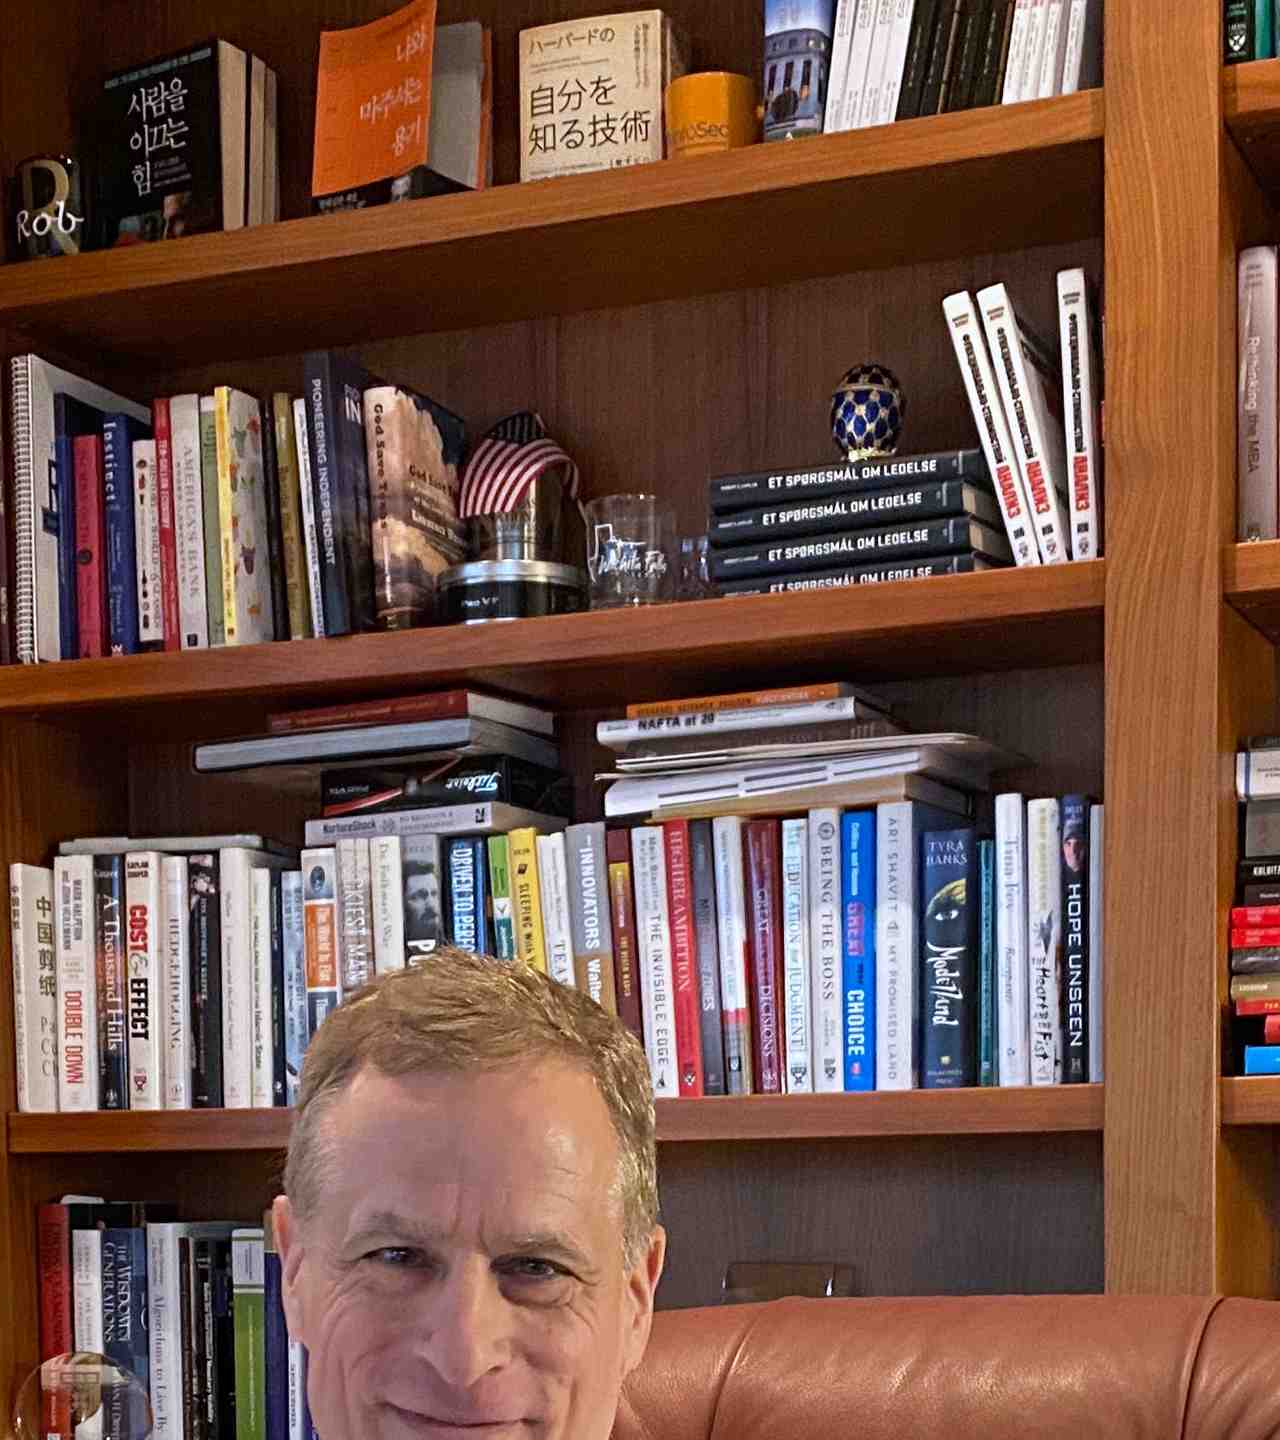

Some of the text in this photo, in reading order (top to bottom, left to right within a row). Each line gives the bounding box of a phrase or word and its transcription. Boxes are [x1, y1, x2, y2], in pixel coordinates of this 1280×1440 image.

[529, 27, 616, 55] ハーバードの
[128, 77, 188, 122] 사람을
[530, 75, 617, 118] 自分を
[129, 118, 190, 159] 이끄는
[528, 110, 652, 157] 知る技術
[132, 161, 151, 197] 힘
[17, 200, 85, 244] Rob
[373, 404, 386, 435] God
[103, 421, 119, 502] Instinct
[311, 378, 336, 566] PIONEERING INDEPENDENT
[375, 441, 388, 478] Save
[768, 475, 784, 489] ET
[785, 465, 860, 487] SPØRGSMÅL
[861, 465, 880, 479] OM
[883, 458, 937, 476] LEDELSE
[1073, 454, 1091, 512] АНАЛИЗ
[1248, 440, 1259, 474] MBA
[762, 511, 777, 525] ET
[778, 500, 848, 523] SPØRGSMÅL
[850, 498, 869, 513] OM
[871, 491, 922, 510] LEDELSE
[995, 464, 1021, 519] АНАЛИЗ
[1025, 460, 1050, 515] АНАЛИЗ
[188, 549, 201, 598] BANK
[638, 712, 715, 731] NAFTA at 20
[926, 854, 968, 866] BANKS
[929, 840, 964, 853] TYRA
[1003, 837, 1019, 910] Tina Fey
[380, 864, 391, 922] Folkman's
[451, 848, 474, 912] DRIVEN TO
[518, 883, 533, 929] SLEEPING
[579, 847, 600, 950] INNOVATORS
[669, 830, 691, 993] HIGHER AMBITION
[820, 845, 834, 1001] BEING THE BOSS
[103, 893, 123, 1051] A Thousand Hills
[130, 904, 150, 1040] COST EFFECT
[887, 817, 898, 1081] ARI SHAVIT MY PROMISED LAND
[1067, 882, 1082, 1046] HOPE UNSEEN
[168, 918, 182, 1049] HEDGEHOGGING
[649, 913, 669, 1066] THE INVISIBLE EDGE
[788, 968, 805, 1047] JUDGMENT
[1034, 967, 1052, 1011] Heart
[64, 990, 84, 1084] DOUBLE DOWN
[846, 989, 866, 1056] CHOICE
[102, 1241, 116, 1343] GENERATIONS
[153, 1293, 168, 1413] Algorithms to Live
